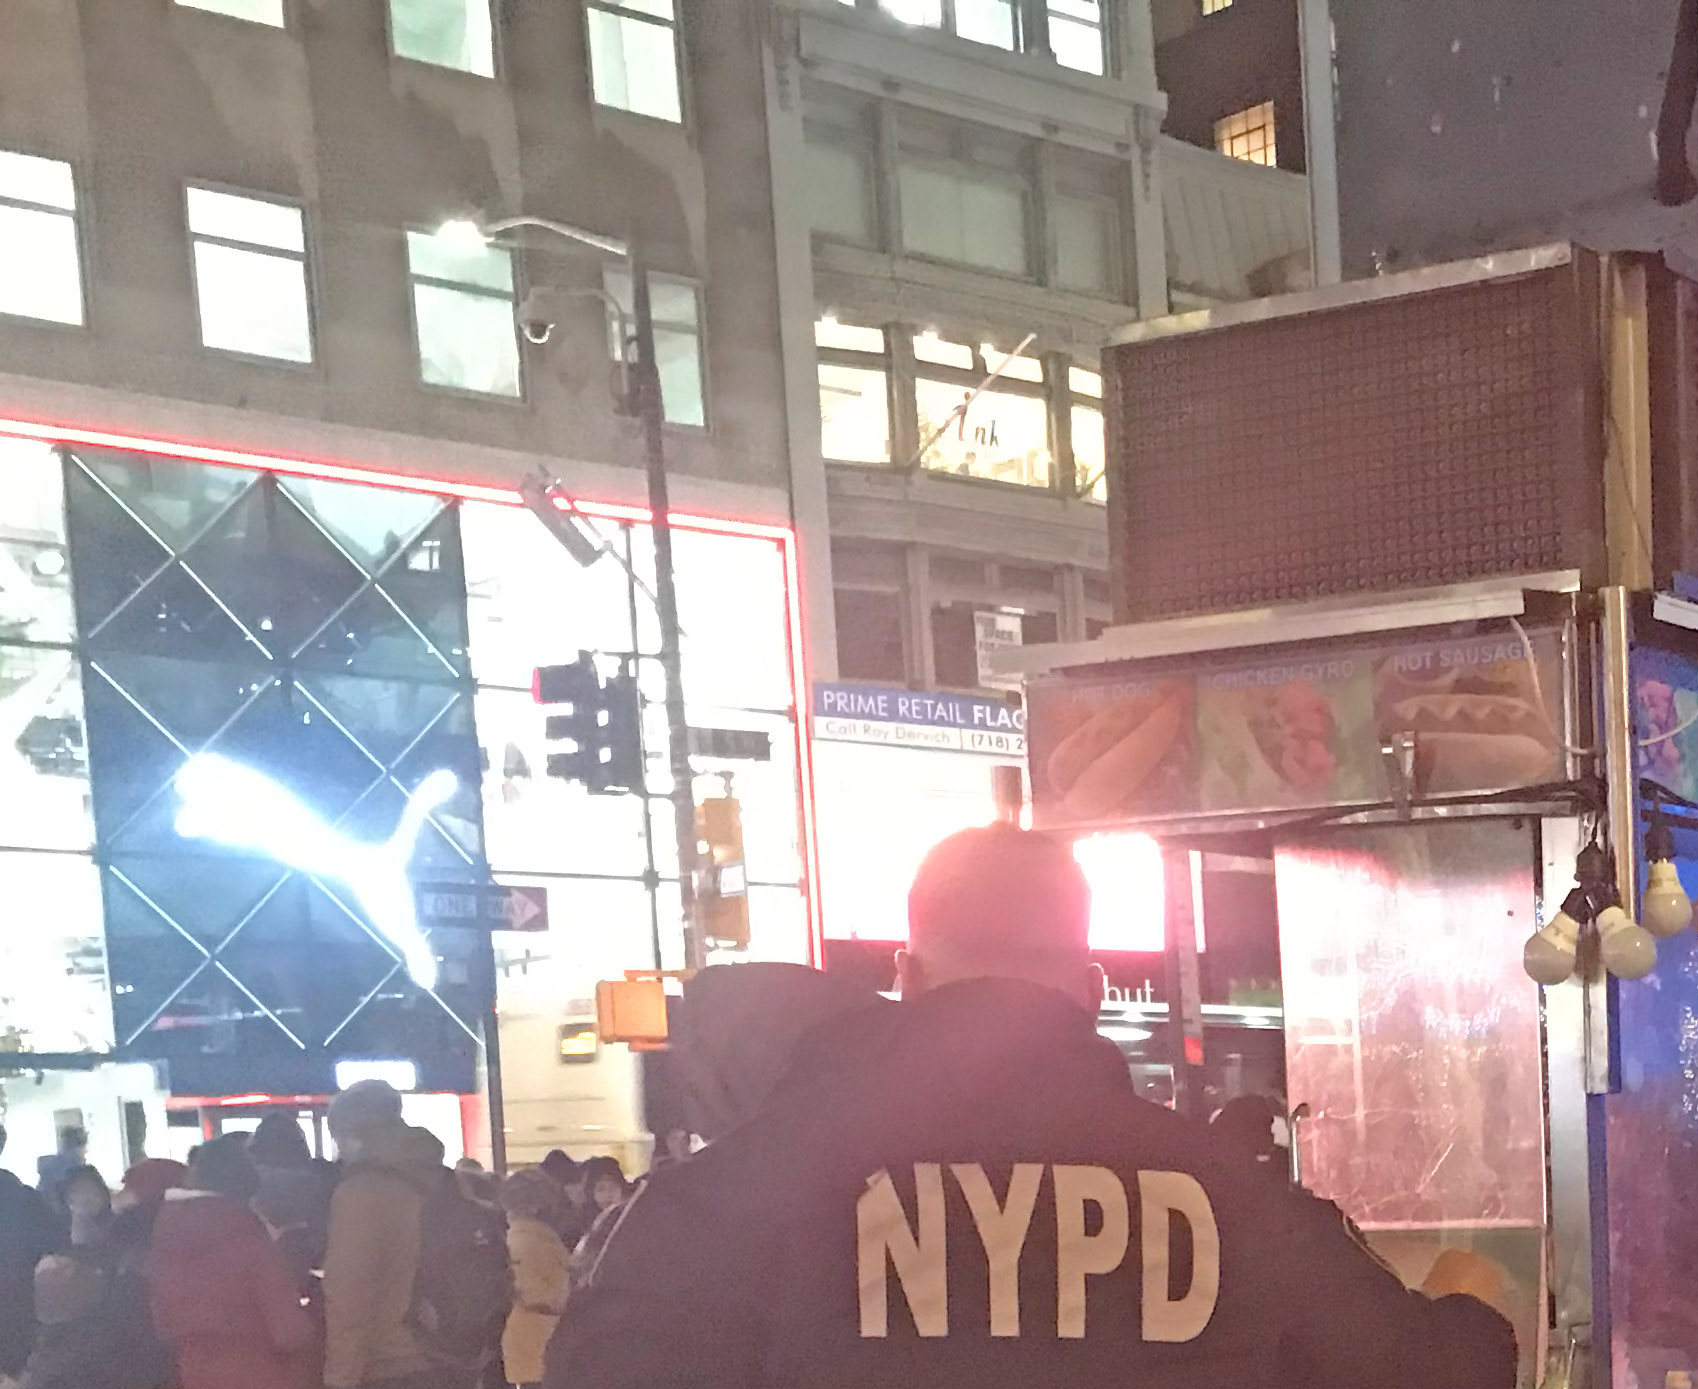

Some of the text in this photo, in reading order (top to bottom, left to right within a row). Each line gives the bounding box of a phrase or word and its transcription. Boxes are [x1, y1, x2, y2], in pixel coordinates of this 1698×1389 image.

[1210, 660, 1354, 691] CHICKEN GYRO
[1393, 652, 1432, 674] HOT
[1111, 682, 1151, 699] DOG
[822, 690, 889, 717] PRIME
[897, 697, 966, 724] RETAIL
[825, 719, 857, 736] Call
[971, 733, 1010, 751] (718)
[856, 1161, 1221, 1343] NYPD
